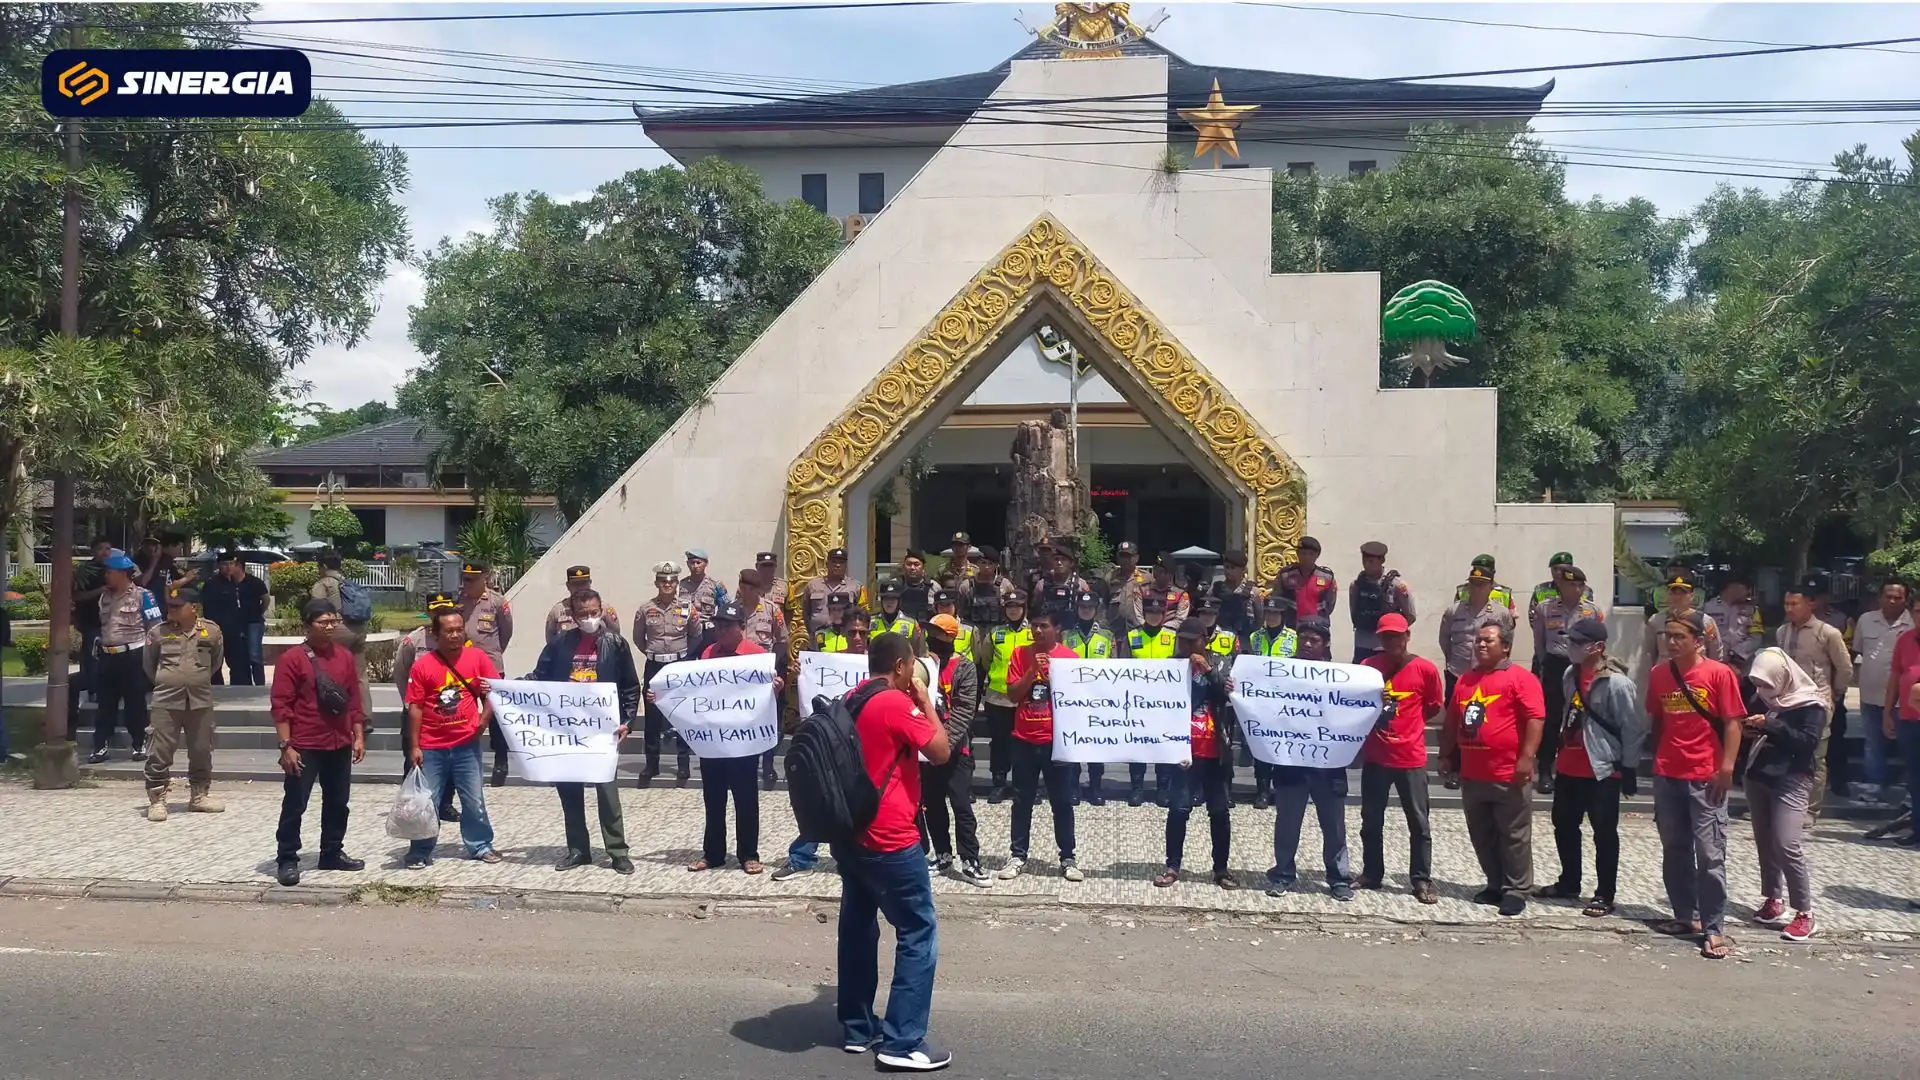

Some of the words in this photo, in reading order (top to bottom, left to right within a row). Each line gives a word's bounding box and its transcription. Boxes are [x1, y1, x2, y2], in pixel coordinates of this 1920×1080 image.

[662, 669, 774, 690] BAYARKAN
[1071, 667, 1181, 684] BAYARKAN
[1263, 661, 1350, 683] BUMD
[496, 690, 551, 706] BUMD
[559, 694, 612, 708] BUKAN
[692, 697, 756, 714] BULAN
[1052, 690, 1120, 709] PESANGON
[1134, 694, 1187, 709] PENSIUN
[502, 712, 540, 728] SAPI
[1088, 715, 1145, 728] BURUH
[515, 730, 590, 748] POLITIK
[1062, 731, 1118, 746] MADIUN
[1243, 720, 1312, 740] PENINDAS
